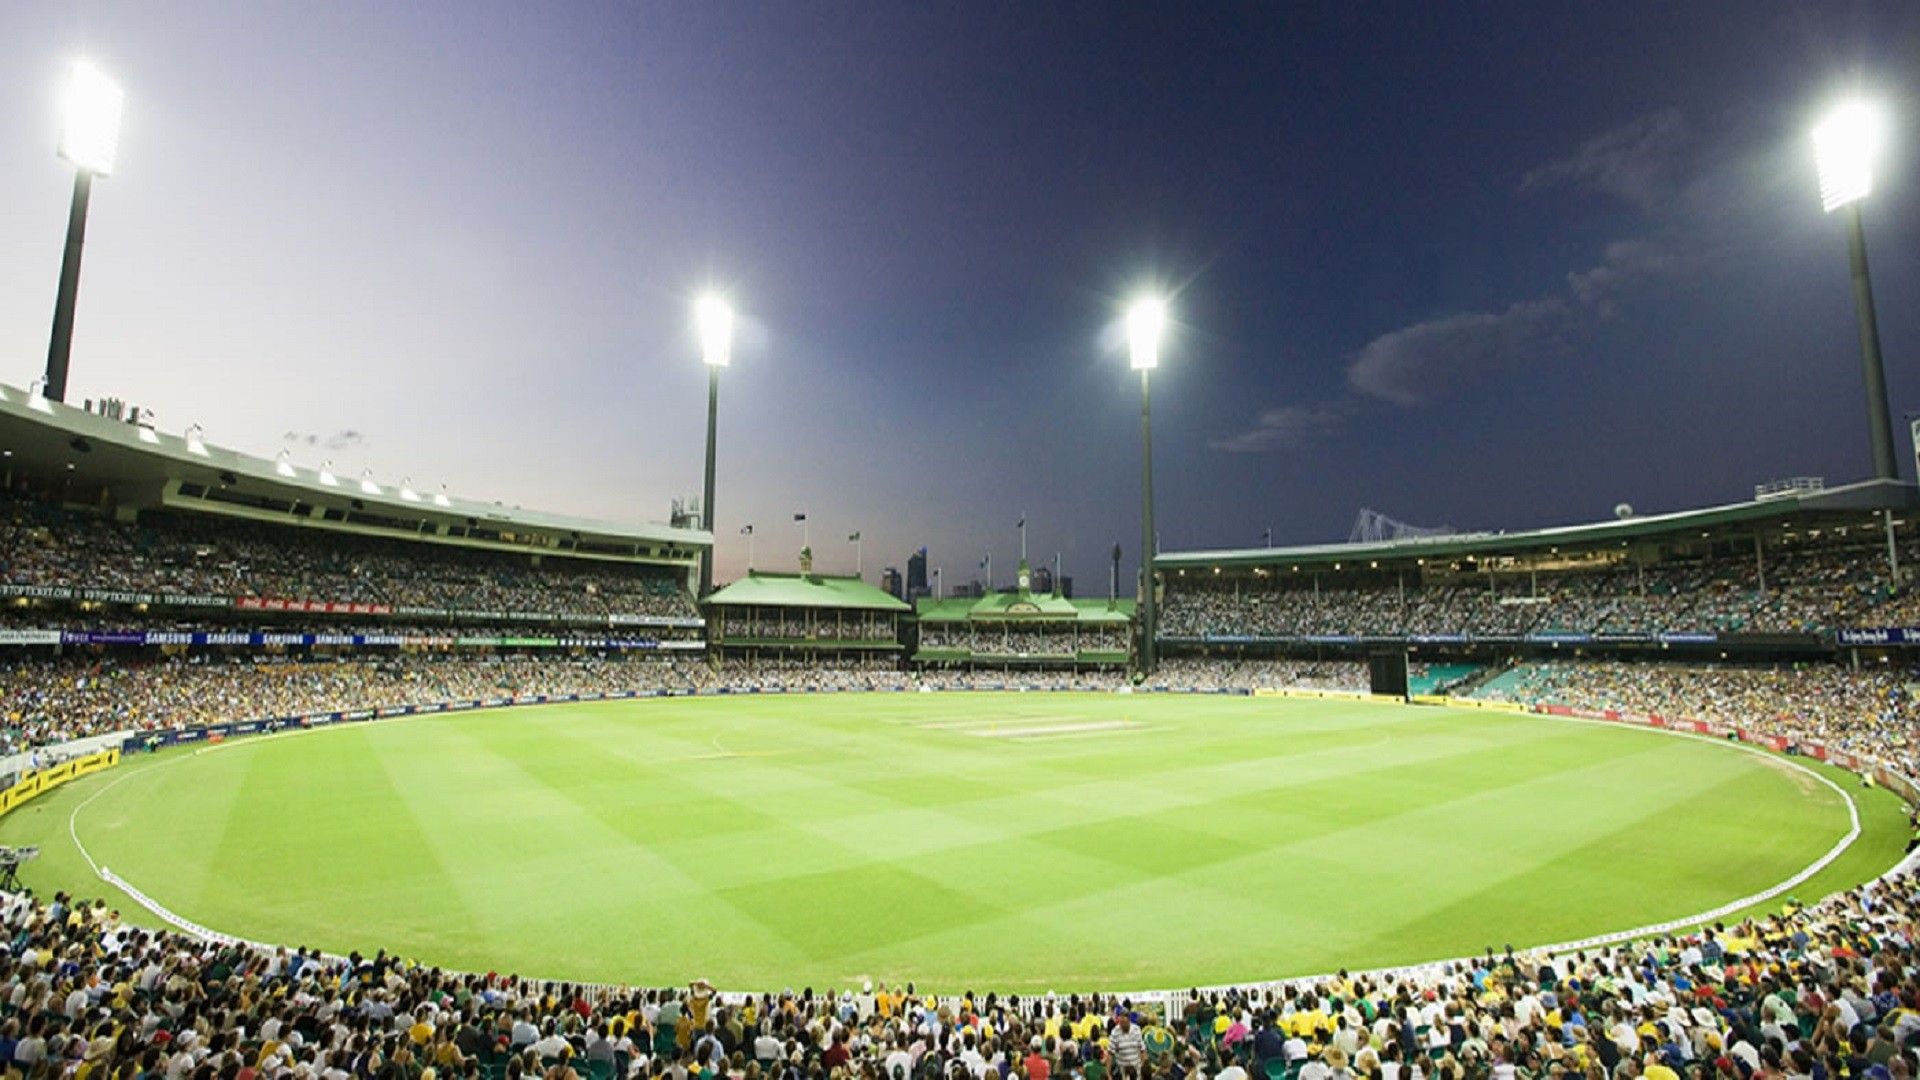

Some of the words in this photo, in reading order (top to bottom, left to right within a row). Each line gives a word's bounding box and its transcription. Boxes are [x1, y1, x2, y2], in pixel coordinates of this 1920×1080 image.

[145, 632, 193, 645] SAMSUNG
[206, 632, 250, 645] SAMSUNG
[263, 633, 303, 645] SAMSUNG
[316, 633, 354, 645] SAMSUNG
[364, 633, 402, 645] SAMSUNG
